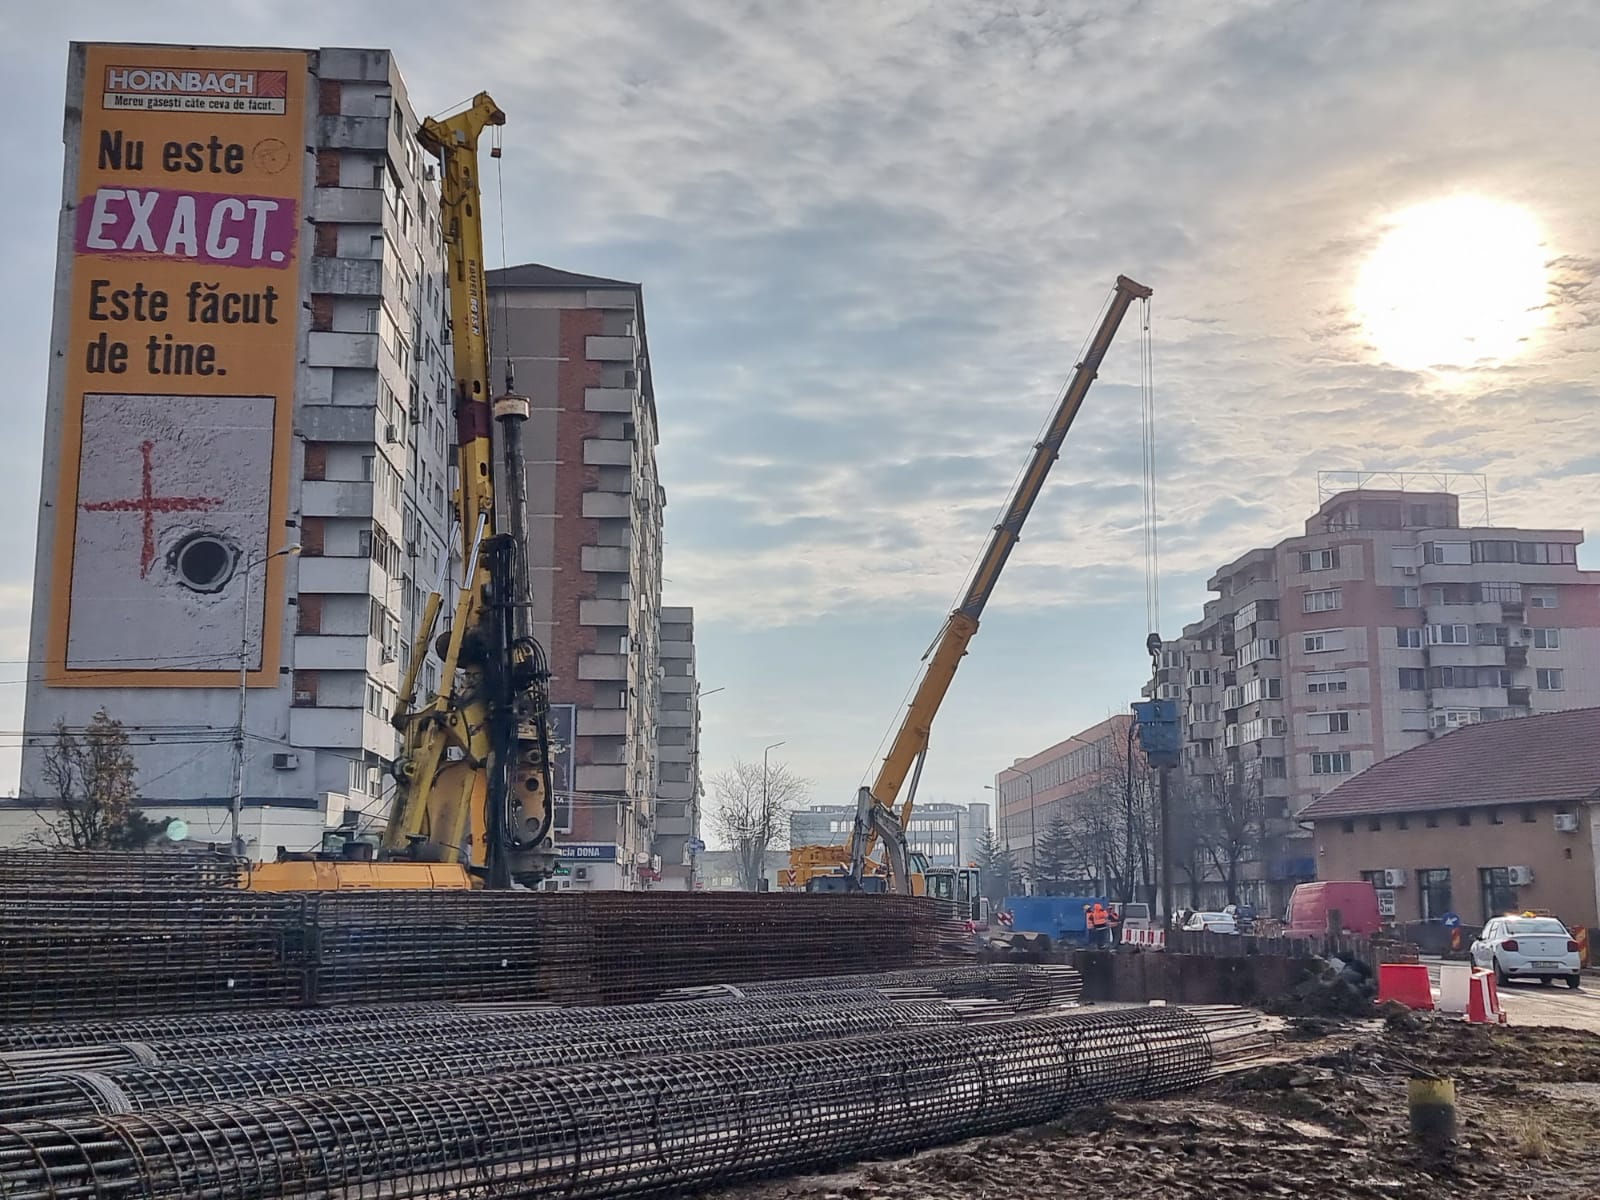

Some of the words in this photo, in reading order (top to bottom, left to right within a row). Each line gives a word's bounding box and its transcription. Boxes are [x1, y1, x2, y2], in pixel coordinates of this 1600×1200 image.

[108, 70, 253, 94] HORNBACH
[233, 99, 245, 110] de
[97, 130, 144, 171] Nu
[162, 135, 245, 174] este
[86, 188, 286, 262] EXACT.
[89, 279, 169, 322] Este
[186, 281, 279, 325] făcut
[86, 332, 128, 375] de
[146, 333, 227, 376] tine.
[576, 847, 600, 857] DONA
